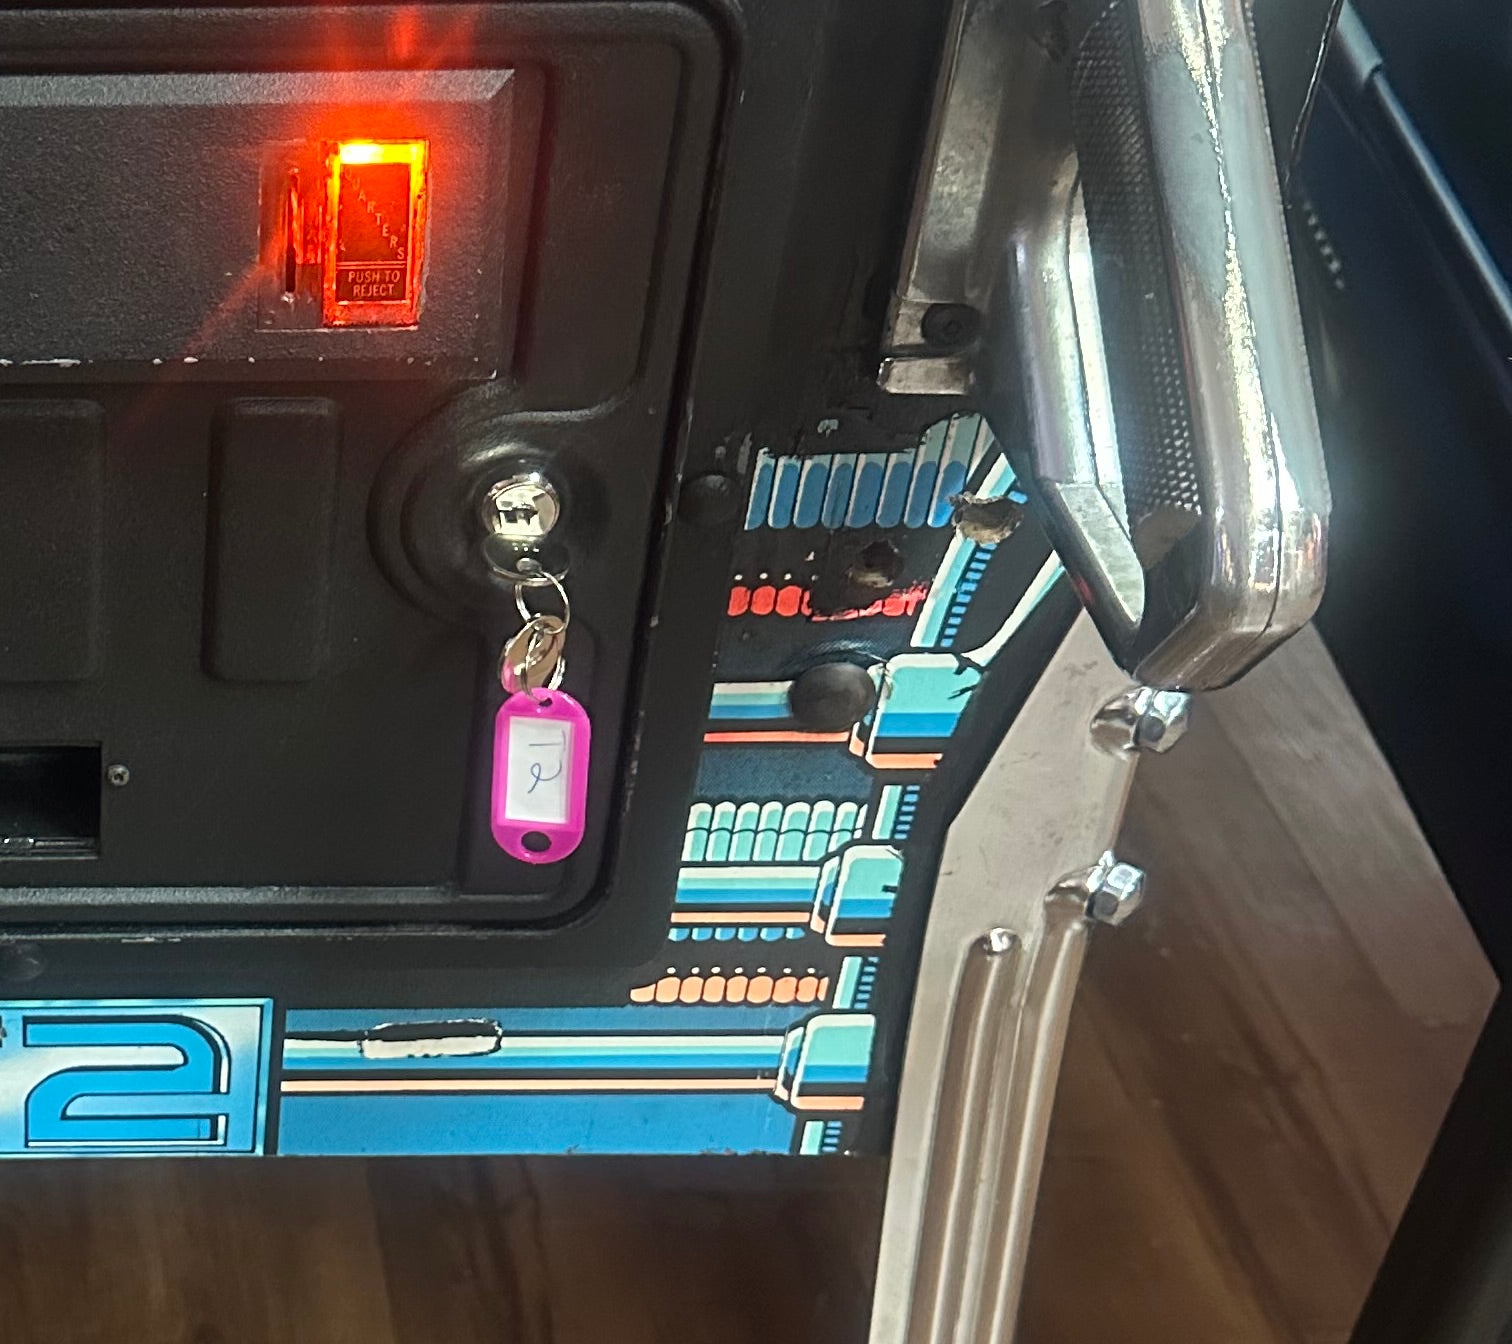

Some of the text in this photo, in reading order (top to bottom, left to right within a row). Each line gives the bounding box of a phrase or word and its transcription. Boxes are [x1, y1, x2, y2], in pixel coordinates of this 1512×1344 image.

[345, 169, 405, 260] QUARTERS
[348, 270, 401, 283] PUSH TO
[353, 283, 395, 297] REJECT
